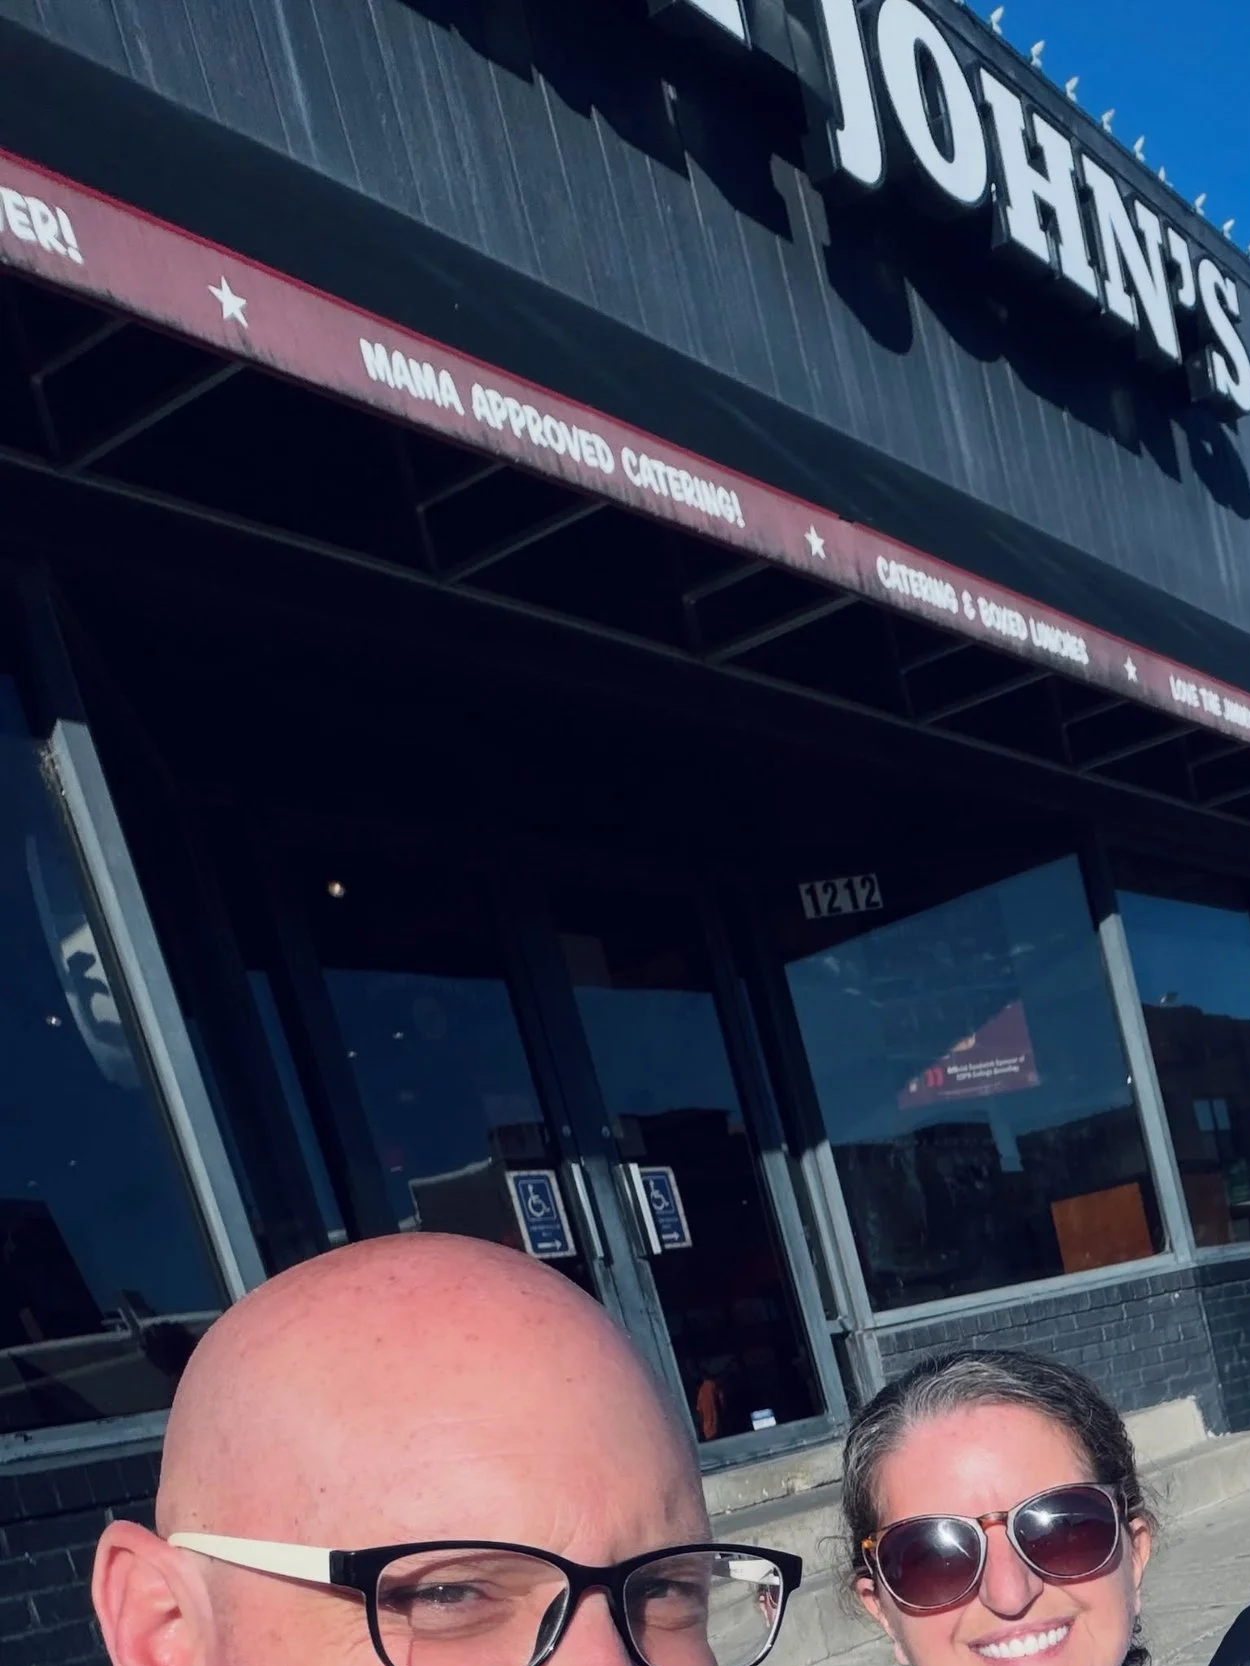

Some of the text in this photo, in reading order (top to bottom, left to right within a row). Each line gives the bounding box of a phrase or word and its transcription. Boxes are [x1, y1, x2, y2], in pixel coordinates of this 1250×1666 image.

[359, 337, 746, 529] MAMA APPROVED CATERING!
[875, 554, 959, 615] CATERING
[804, 875, 882, 917] 1212
